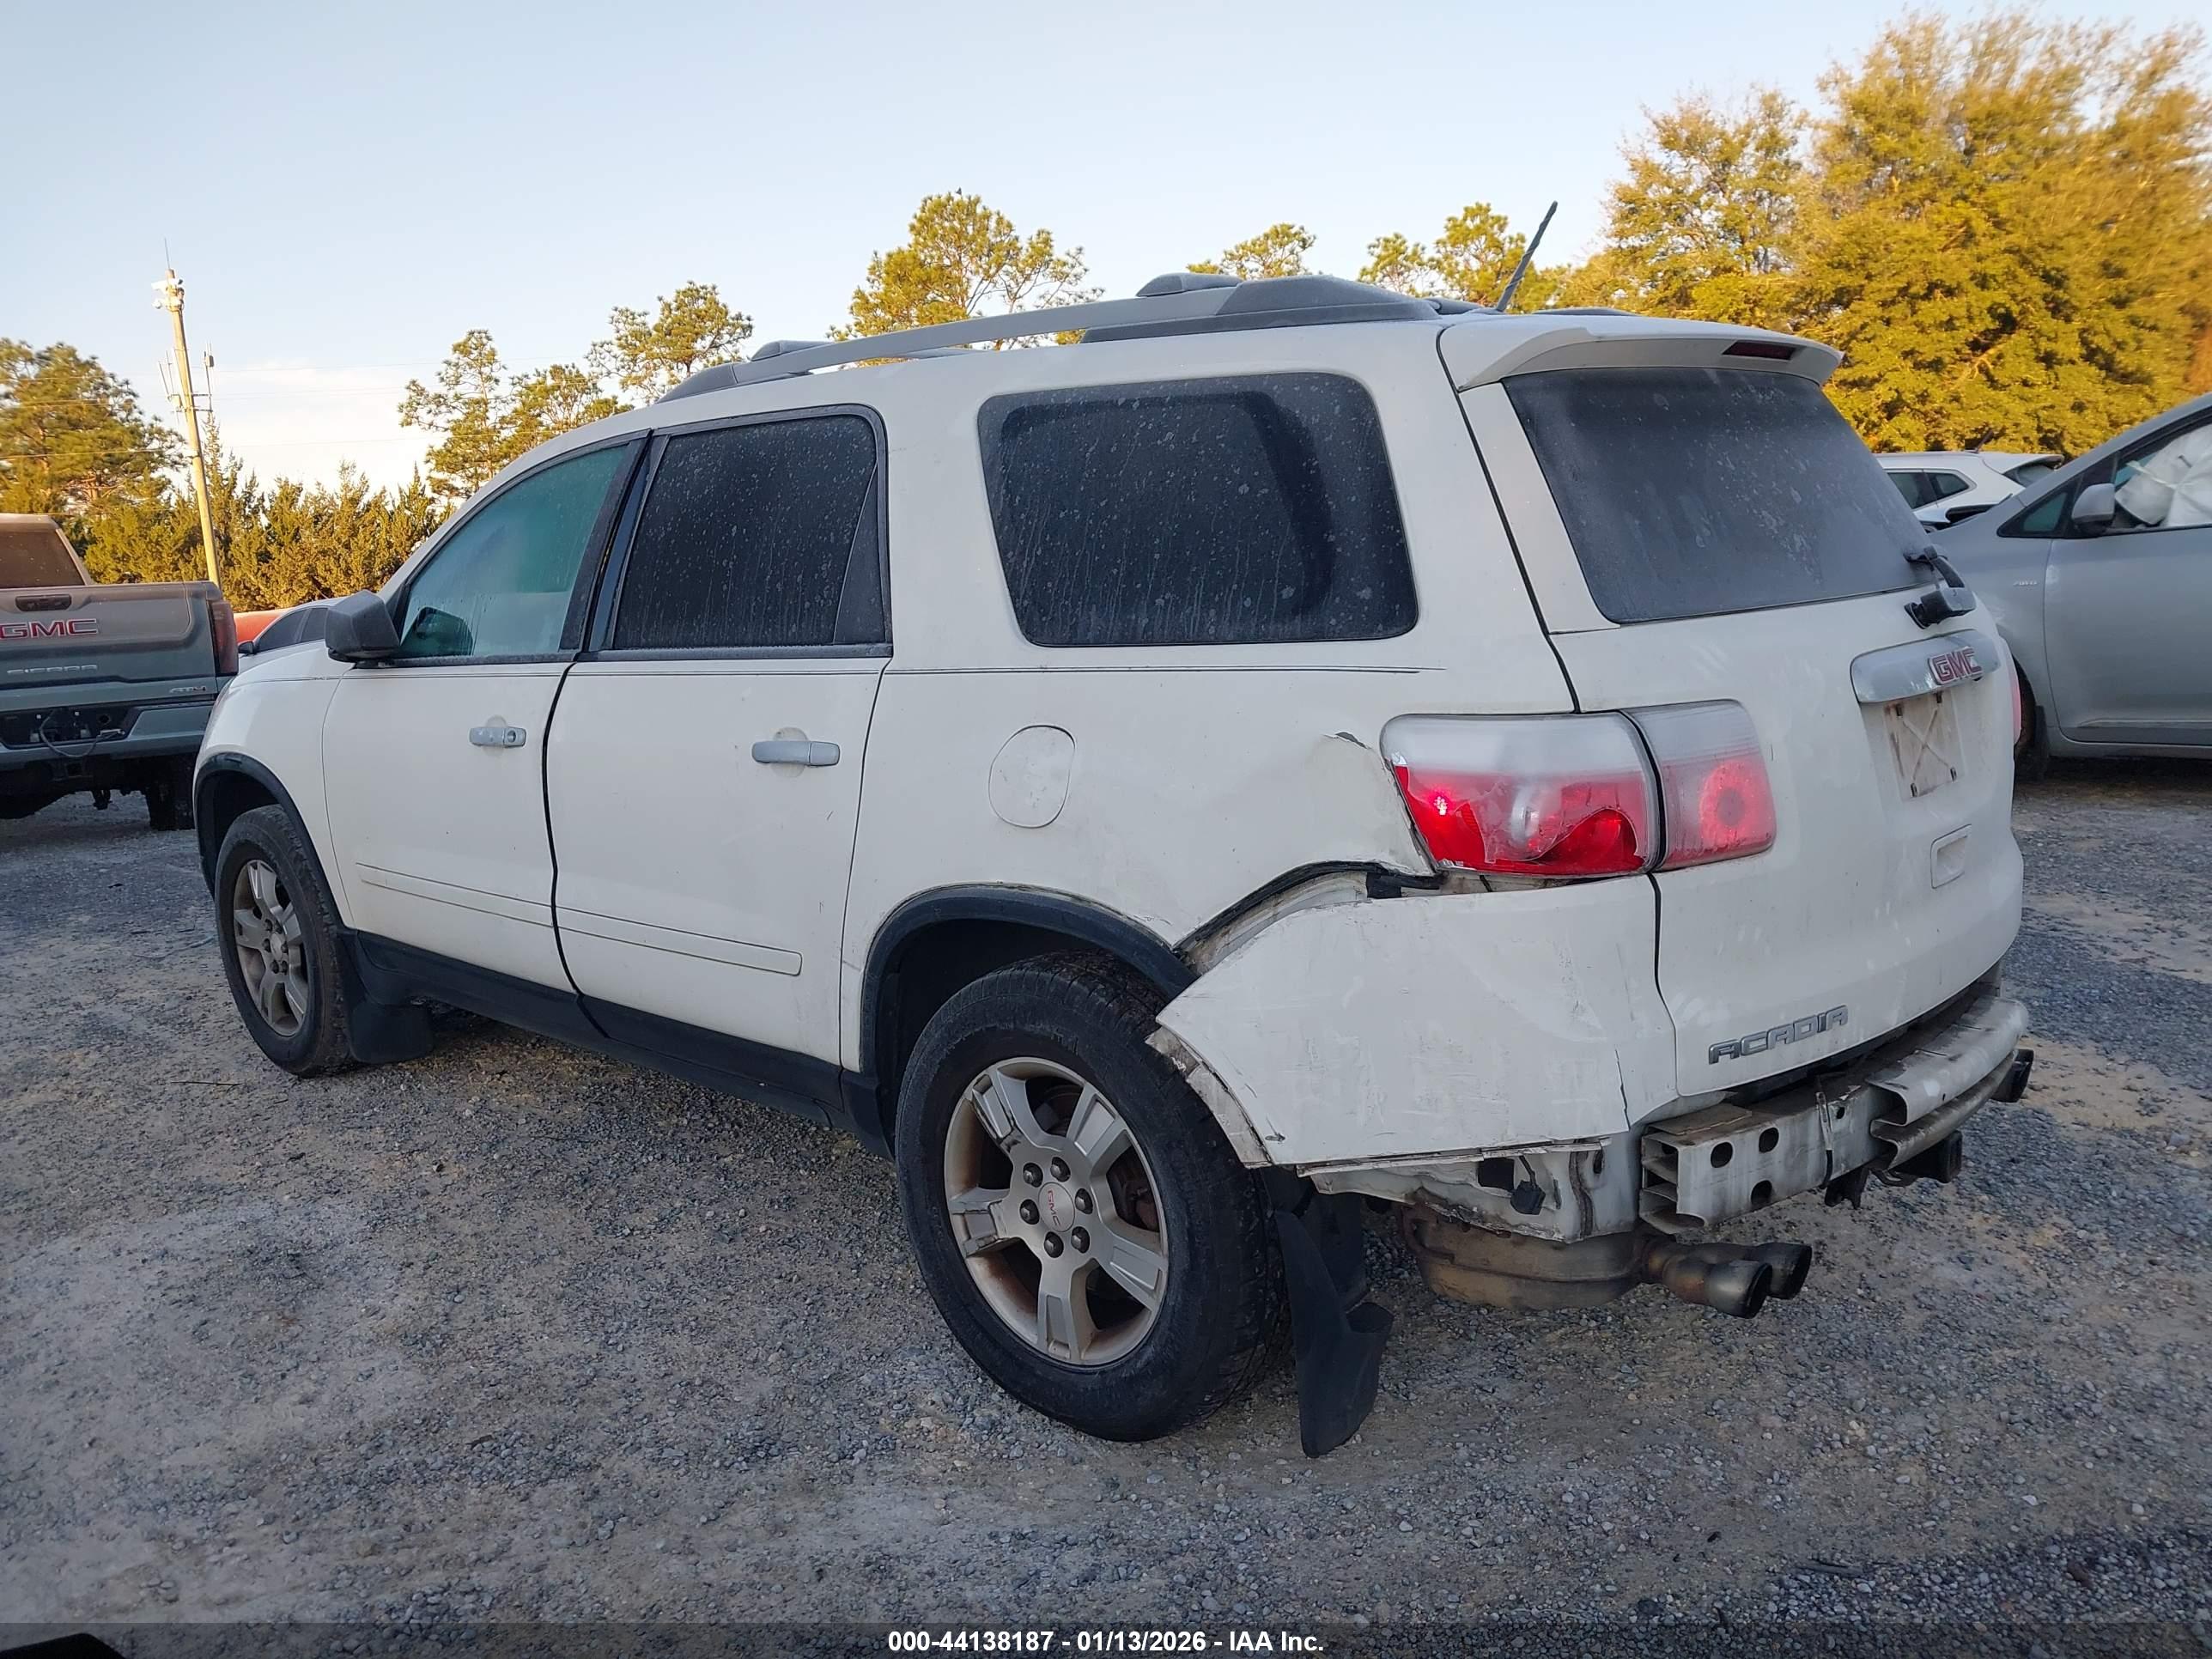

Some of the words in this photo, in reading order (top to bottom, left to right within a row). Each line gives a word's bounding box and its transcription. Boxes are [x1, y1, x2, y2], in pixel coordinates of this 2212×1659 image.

[0, 618, 98, 640] GMC
[1929, 647, 1983, 684] GMC
[1709, 1004, 1848, 1065] ACADIA
[1048, 1190, 1061, 1226] GMC
